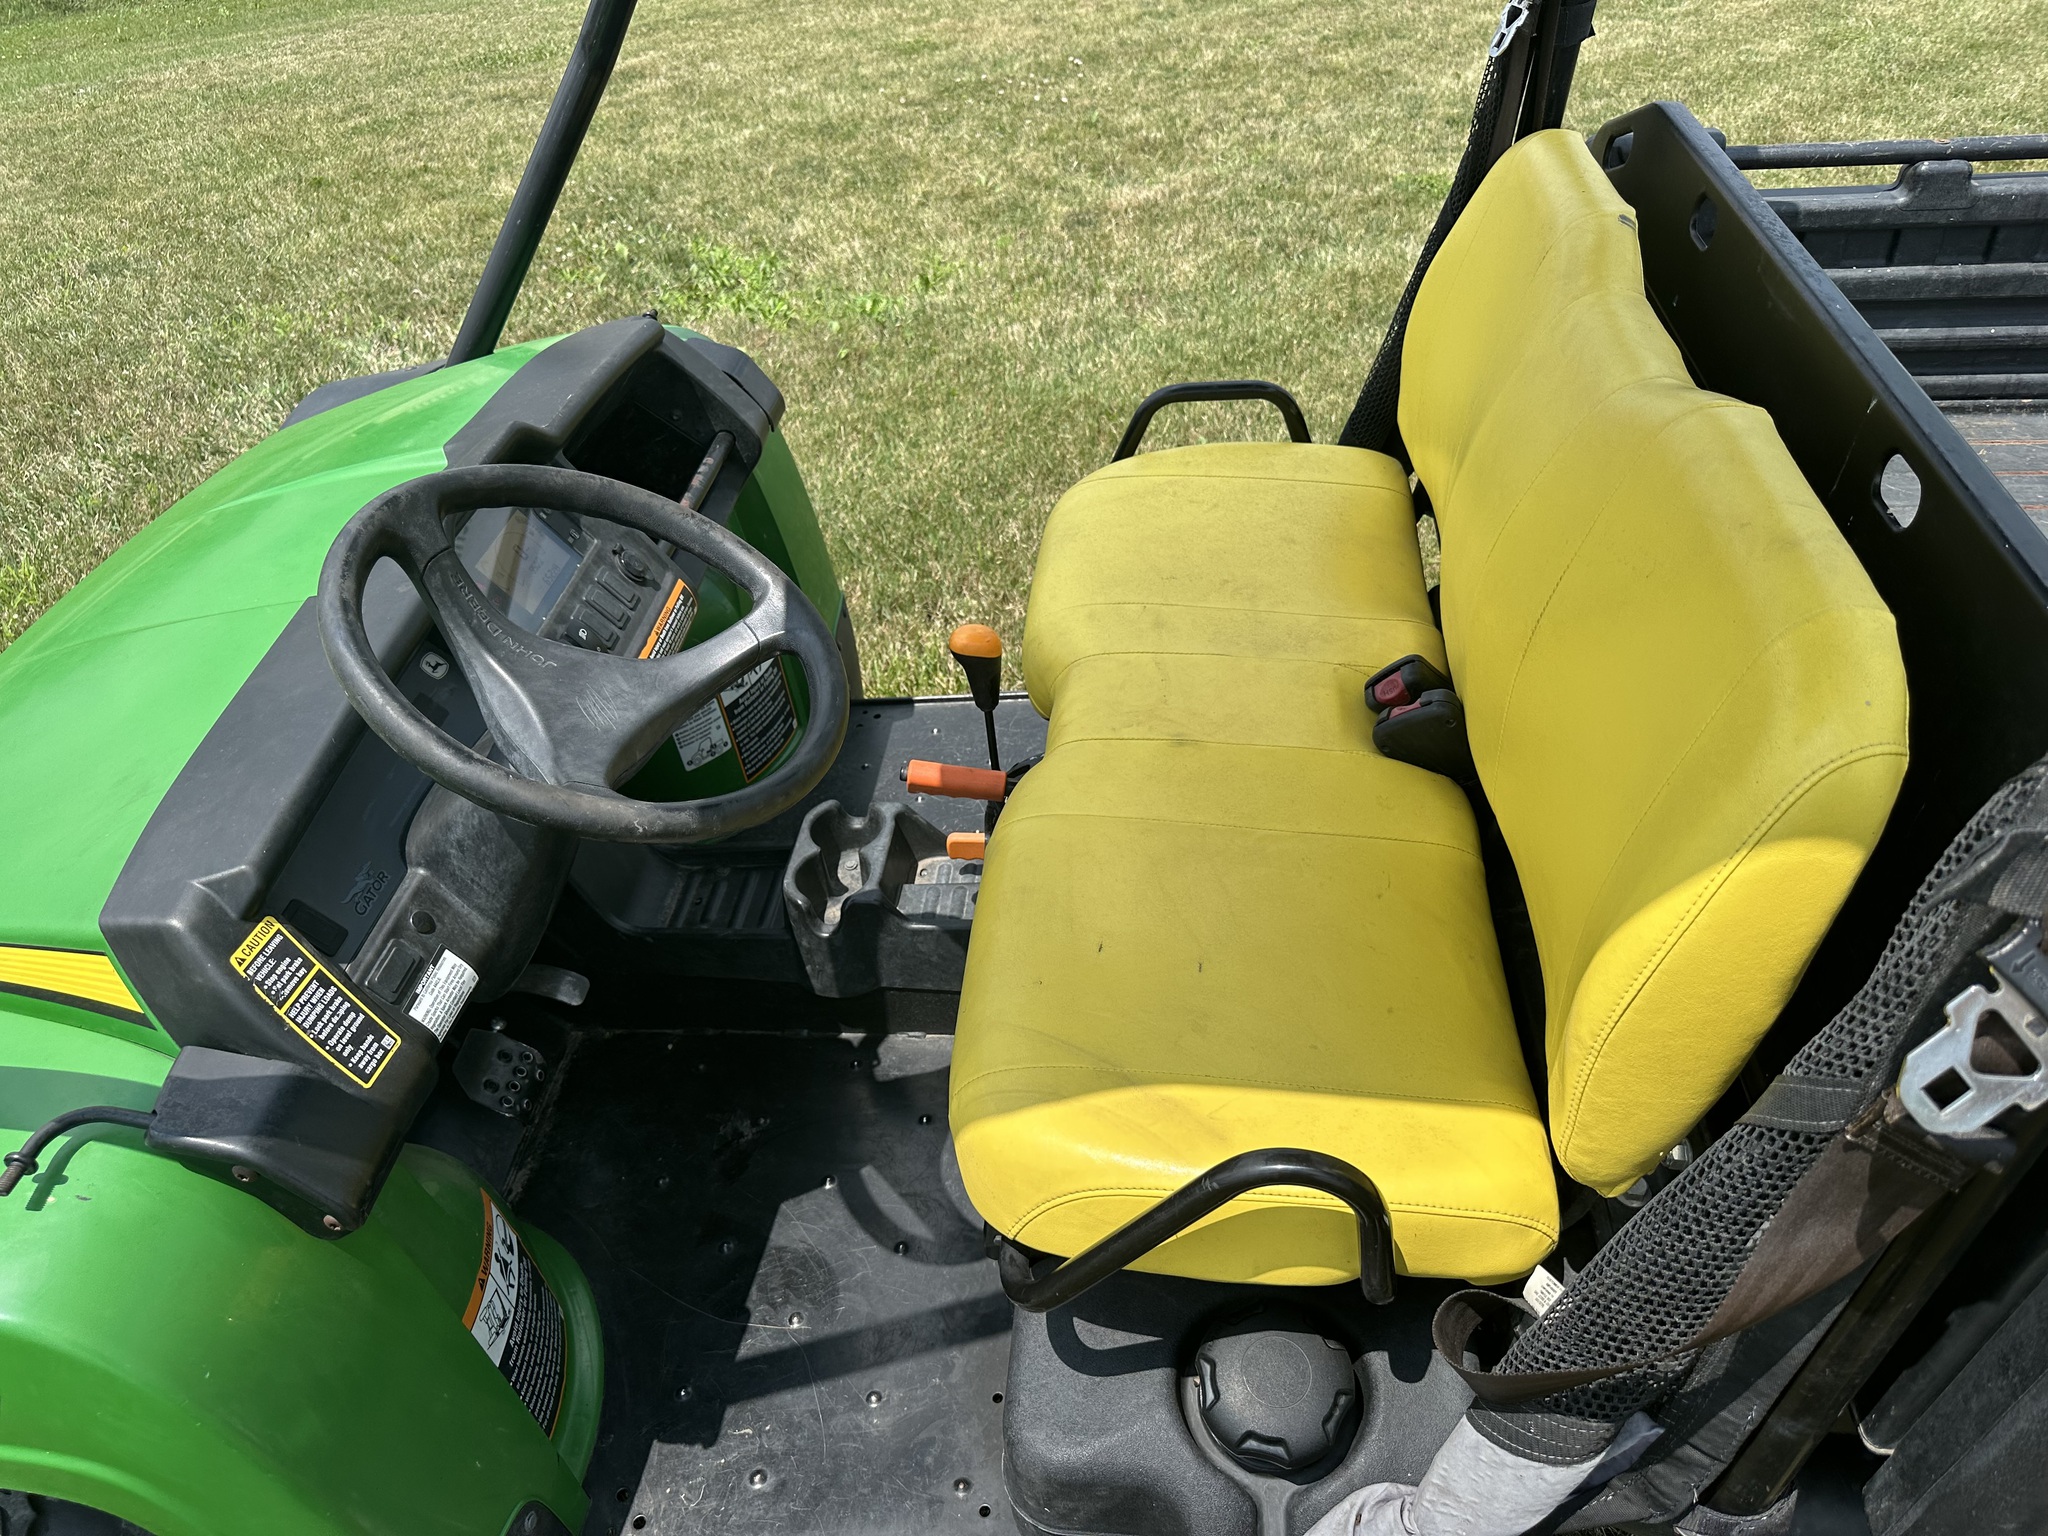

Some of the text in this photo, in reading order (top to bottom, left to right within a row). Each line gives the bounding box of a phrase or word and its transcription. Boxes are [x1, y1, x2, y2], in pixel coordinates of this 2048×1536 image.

[449, 570, 557, 668] JOHN DEERE
[655, 605, 670, 632] WARNING
[354, 870, 389, 916] GATOR
[240, 919, 276, 958] CAUTION
[245, 932, 284, 976] BEFORE LEAVING
[264, 955, 292, 988] Stop engine
[279, 968, 293, 984] park
[287, 955, 303, 973] brake
[295, 965, 308, 979] key
[415, 963, 435, 995] IMPORTANT
[287, 979, 320, 1019] HELP PREVENT
[294, 985, 326, 1024] INJURY WHEN
[301, 984, 338, 1030] DUMPING LOADS
[481, 1220, 492, 1277] WARNING
